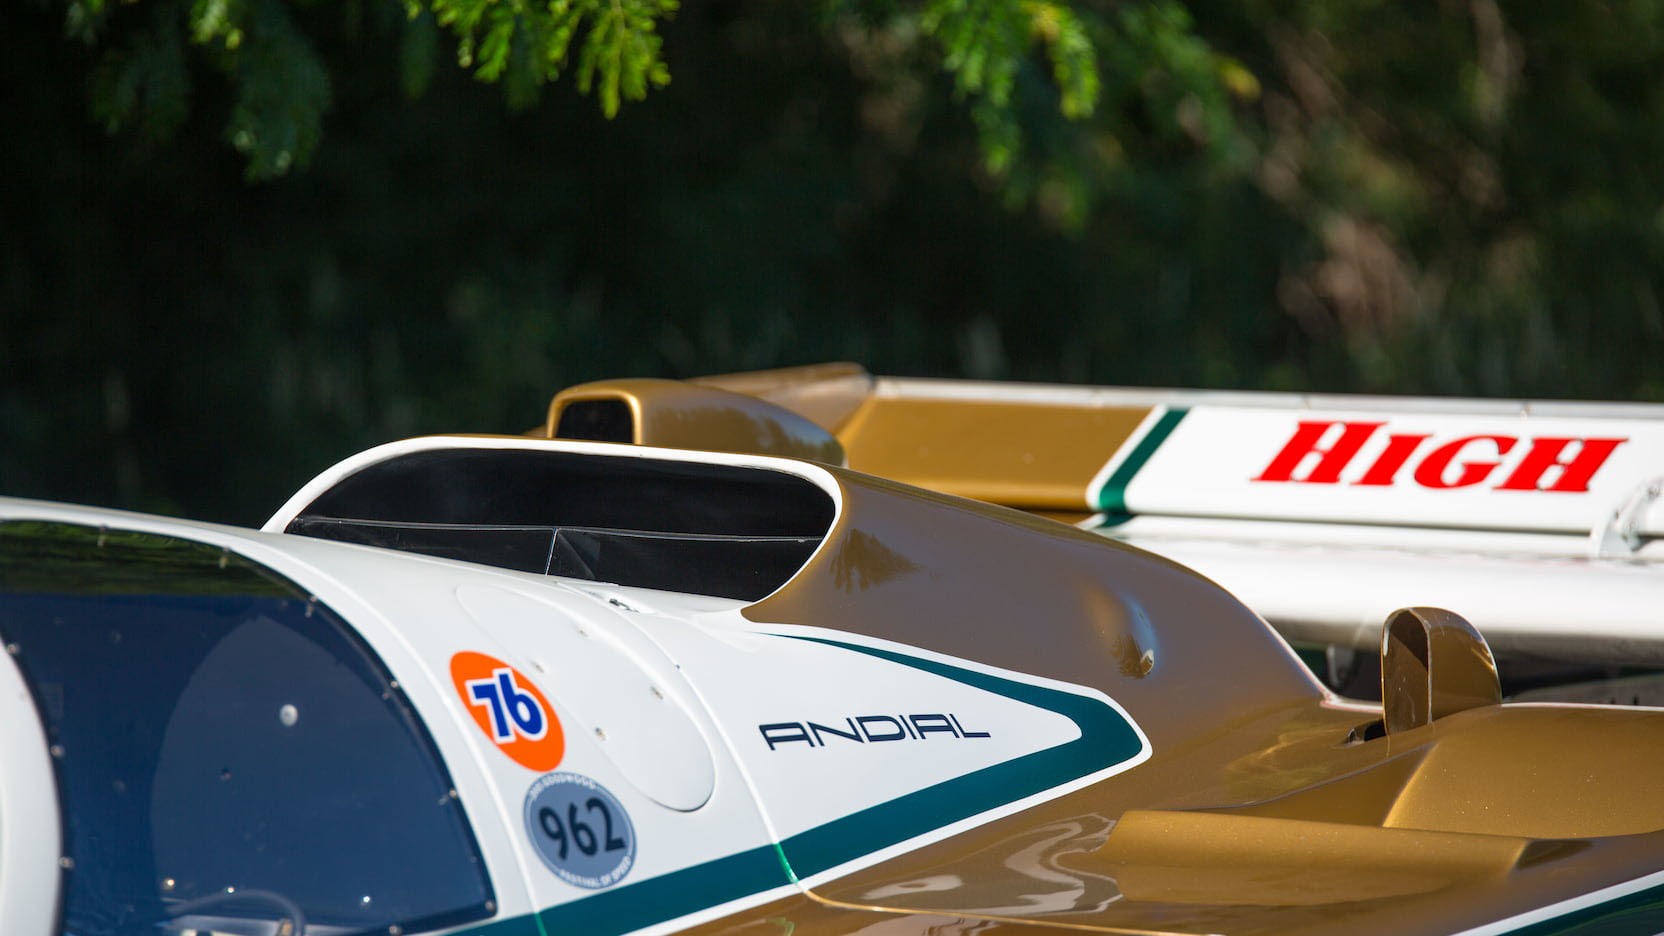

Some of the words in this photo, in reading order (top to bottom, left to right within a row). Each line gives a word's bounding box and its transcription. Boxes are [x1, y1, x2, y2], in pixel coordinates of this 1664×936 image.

[1253, 420, 1628, 493] HIGH
[469, 671, 545, 740] 76
[759, 713, 991, 751] ANDIAL
[539, 796, 626, 861] 962
